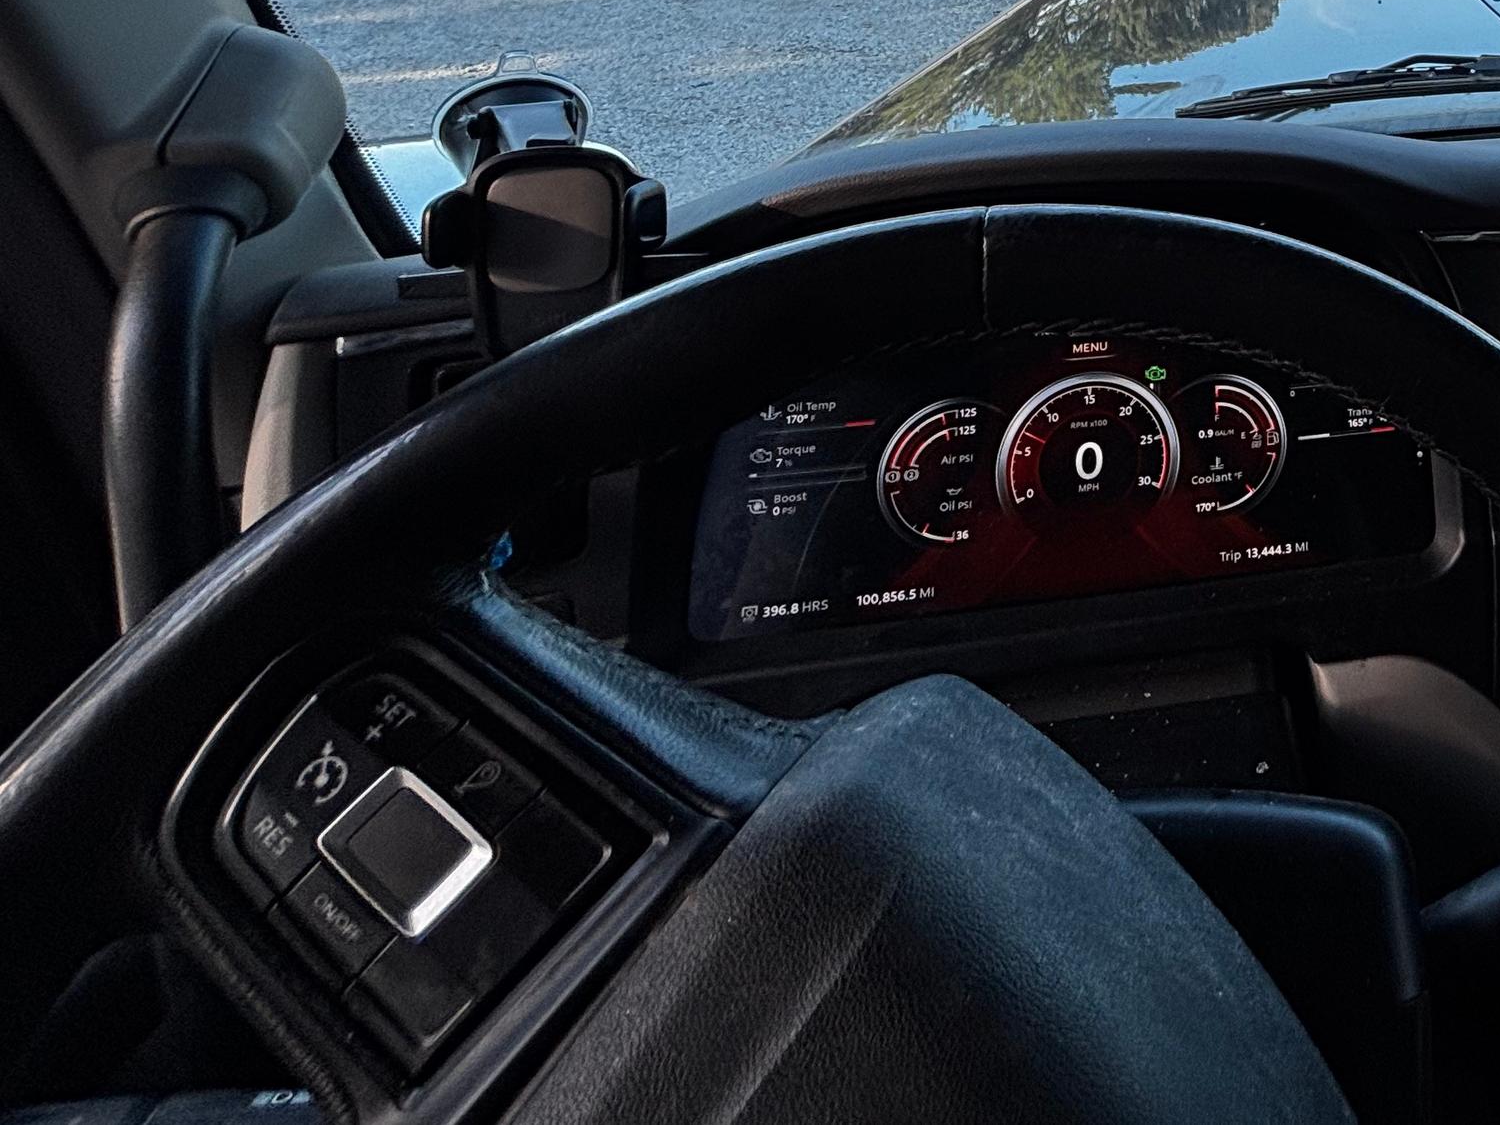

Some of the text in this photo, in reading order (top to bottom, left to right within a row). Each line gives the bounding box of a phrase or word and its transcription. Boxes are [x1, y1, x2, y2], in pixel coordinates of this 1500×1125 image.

[1072, 341, 1109, 354] MENU
[1083, 394, 1096, 405] 15
[787, 401, 837, 413] Oil Temp
[1119, 406, 1133, 416] 20
[960, 408, 977, 418] 125
[1047, 413, 1059, 423] 10
[959, 425, 976, 435] 125
[1070, 421, 1088, 430] RPM
[1140, 434, 1153, 445] 25
[1198, 429, 1214, 439] 0.9
[777, 445, 816, 457] Torque
[1024, 447, 1031, 456] 5
[775, 458, 783, 468] 7
[940, 454, 974, 465] Air PSI
[1075, 441, 1104, 480] 0
[1138, 476, 1151, 486] 30
[1191, 472, 1232, 485] Coolant
[1026, 488, 1034, 498] 0
[1078, 483, 1100, 493] MPH
[774, 492, 807, 504] Boost
[772, 506, 781, 516] 0
[939, 501, 973, 512] Oil PSI
[957, 531, 969, 541] 36
[1219, 541, 1309, 563] Trip 13,444.3 MI
[856, 587, 935, 607] 100,856.5 MI
[762, 599, 829, 618] 396.8 HRS
[376, 693, 416, 727] SET
[253, 815, 293, 857] RES
